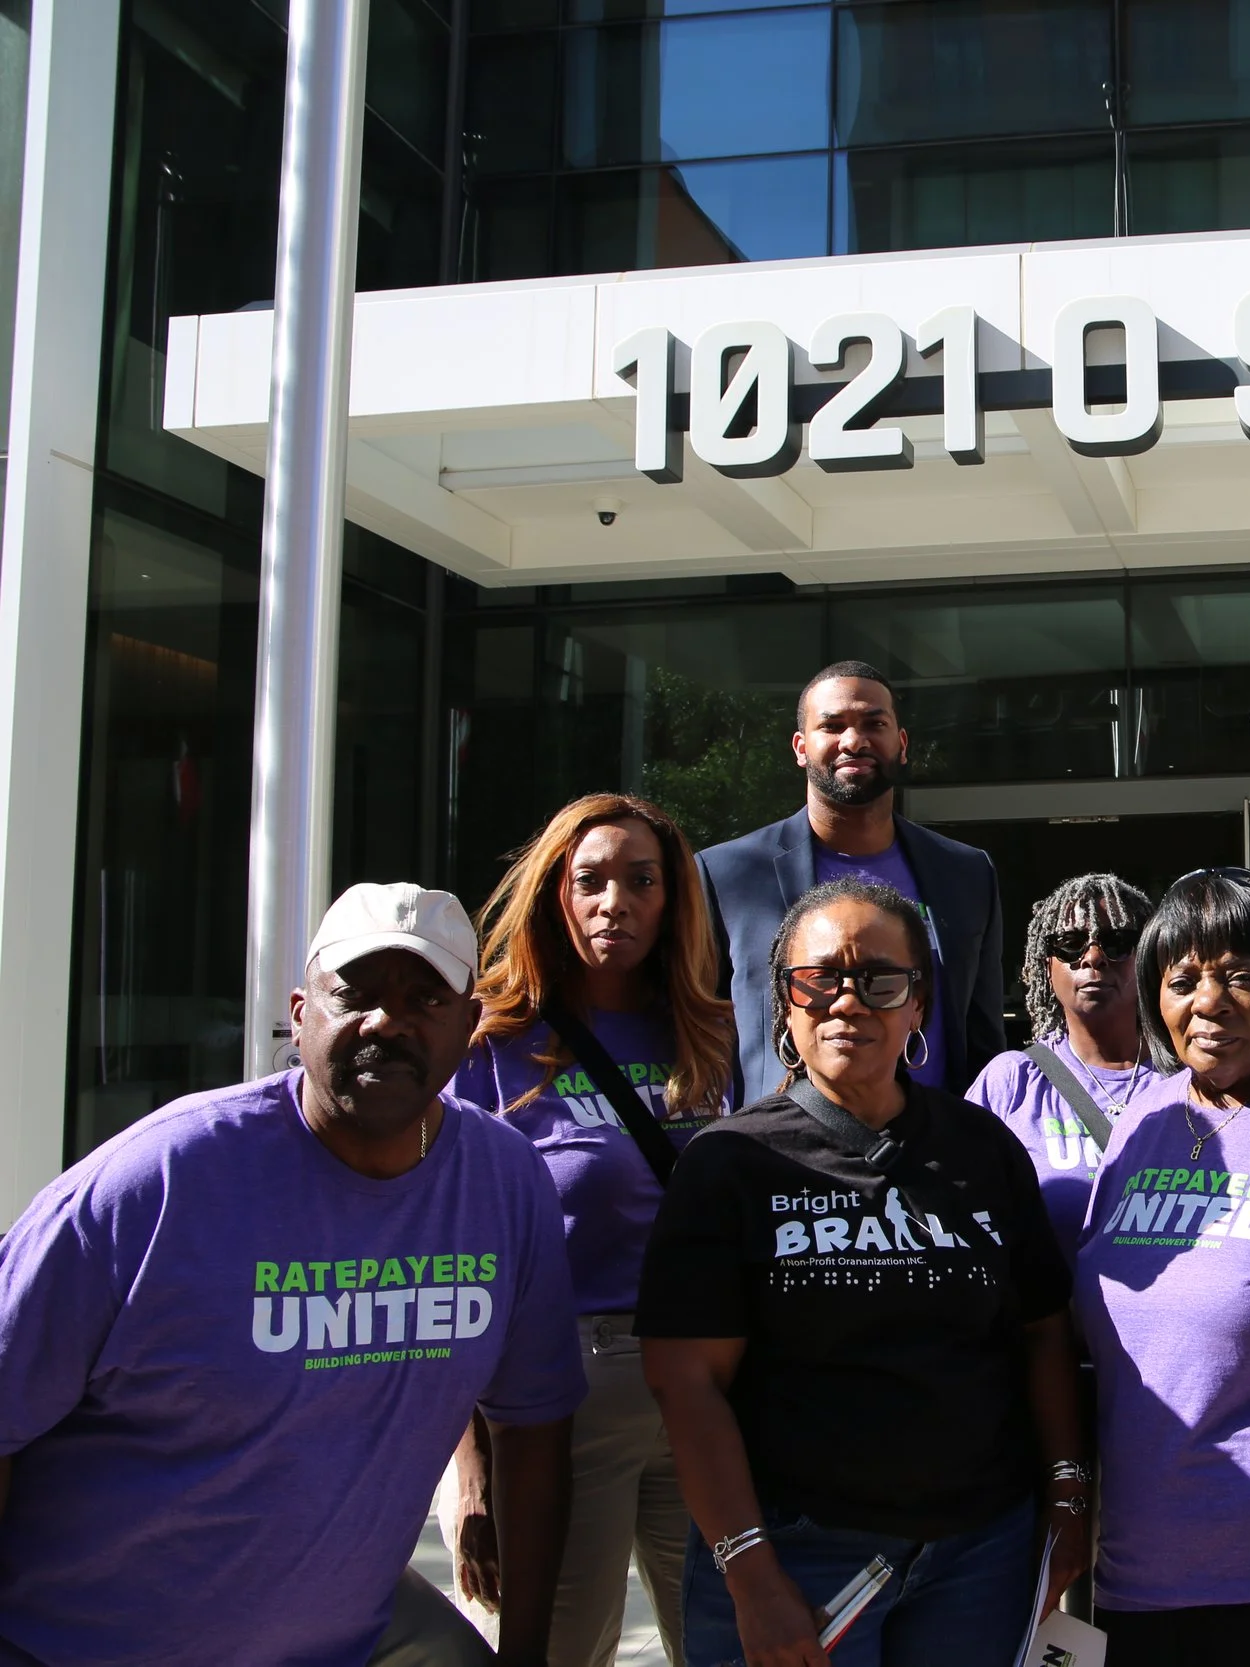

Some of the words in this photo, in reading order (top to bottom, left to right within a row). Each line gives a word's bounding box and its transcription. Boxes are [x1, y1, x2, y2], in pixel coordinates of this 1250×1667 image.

[611, 305, 985, 484] 1021
[771, 1187, 861, 1214] Bright
[1113, 1236, 1152, 1246] BUILDING
[1152, 1237, 1186, 1247] POWER
[1187, 1238, 1200, 1248] TO
[1200, 1239, 1223, 1249] WIN
[255, 1253, 497, 1293] RATEPAYERS
[787, 1257, 836, 1267] Non-Profit
[907, 1256, 927, 1265] INC.
[252, 1286, 493, 1353] UNITED
[304, 1353, 361, 1370] BUILDING
[363, 1350, 406, 1363] POWER
[407, 1349, 422, 1360] TO
[425, 1347, 451, 1359] WIN
